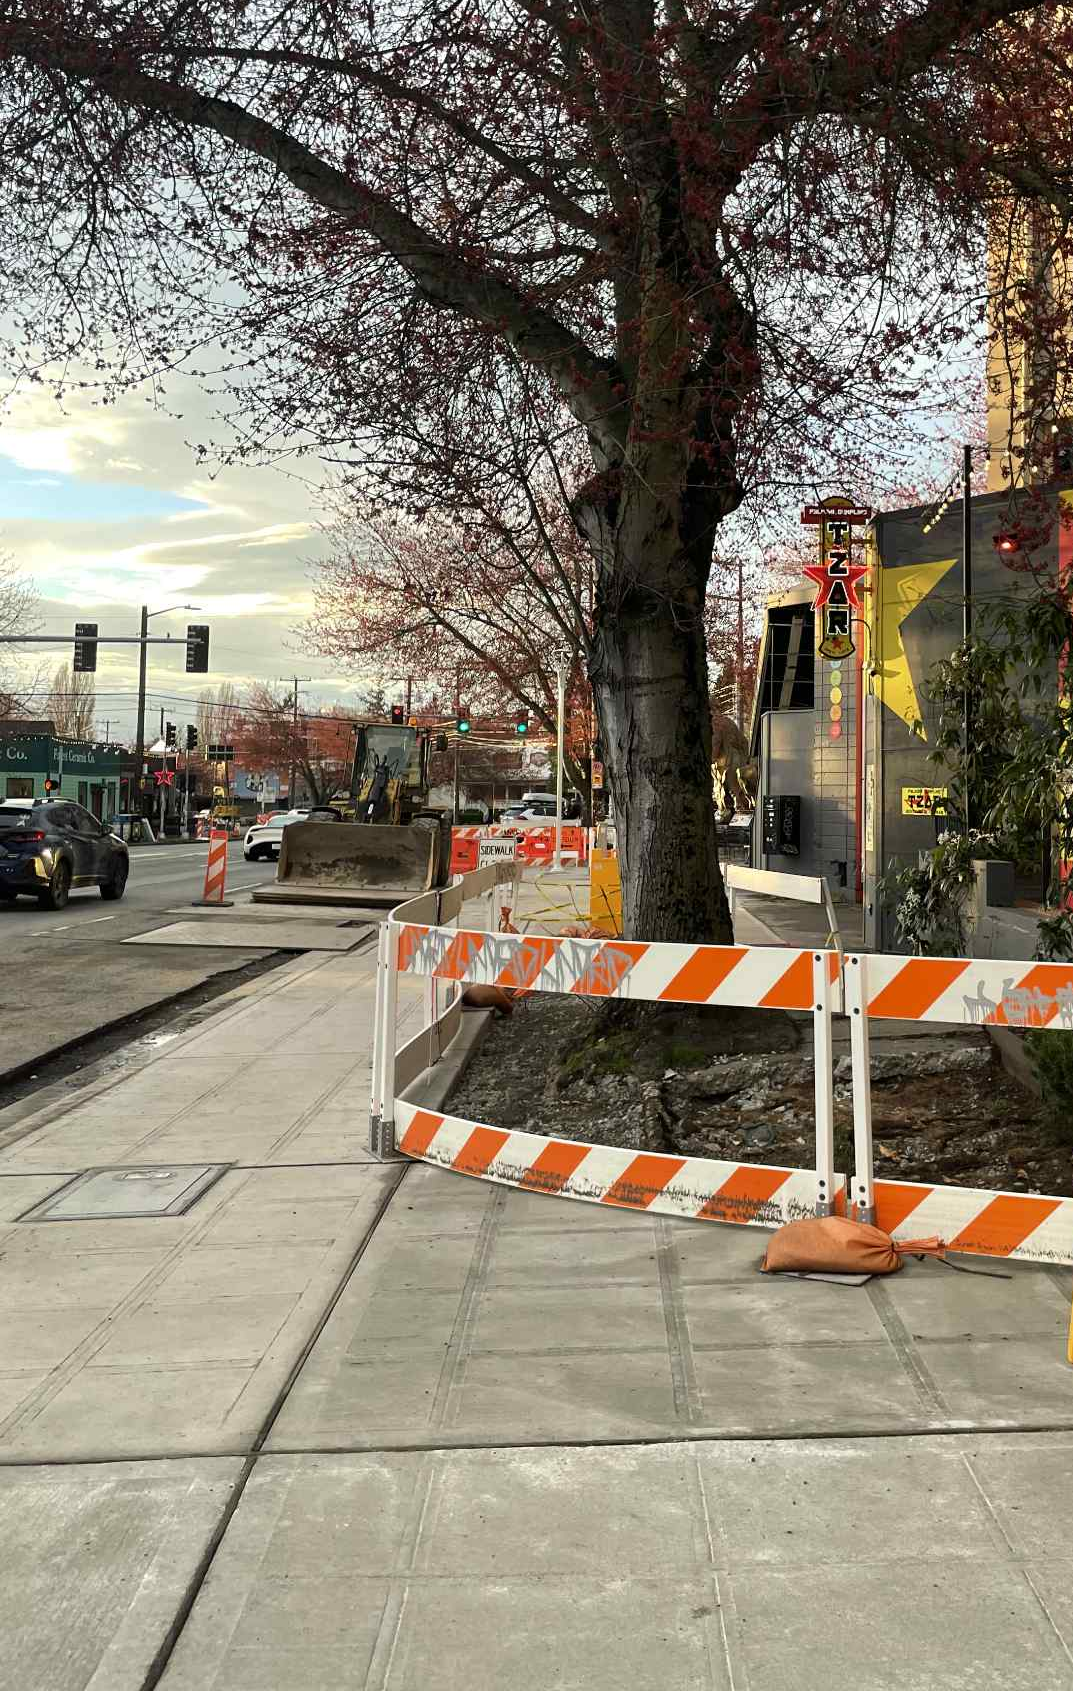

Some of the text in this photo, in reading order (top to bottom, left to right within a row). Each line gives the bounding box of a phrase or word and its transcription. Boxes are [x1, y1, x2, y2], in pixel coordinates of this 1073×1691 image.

[826, 521, 850, 636] TZAR
[6, 746, 28, 760] Co.
[480, 845, 513, 856] SIDEWALK
